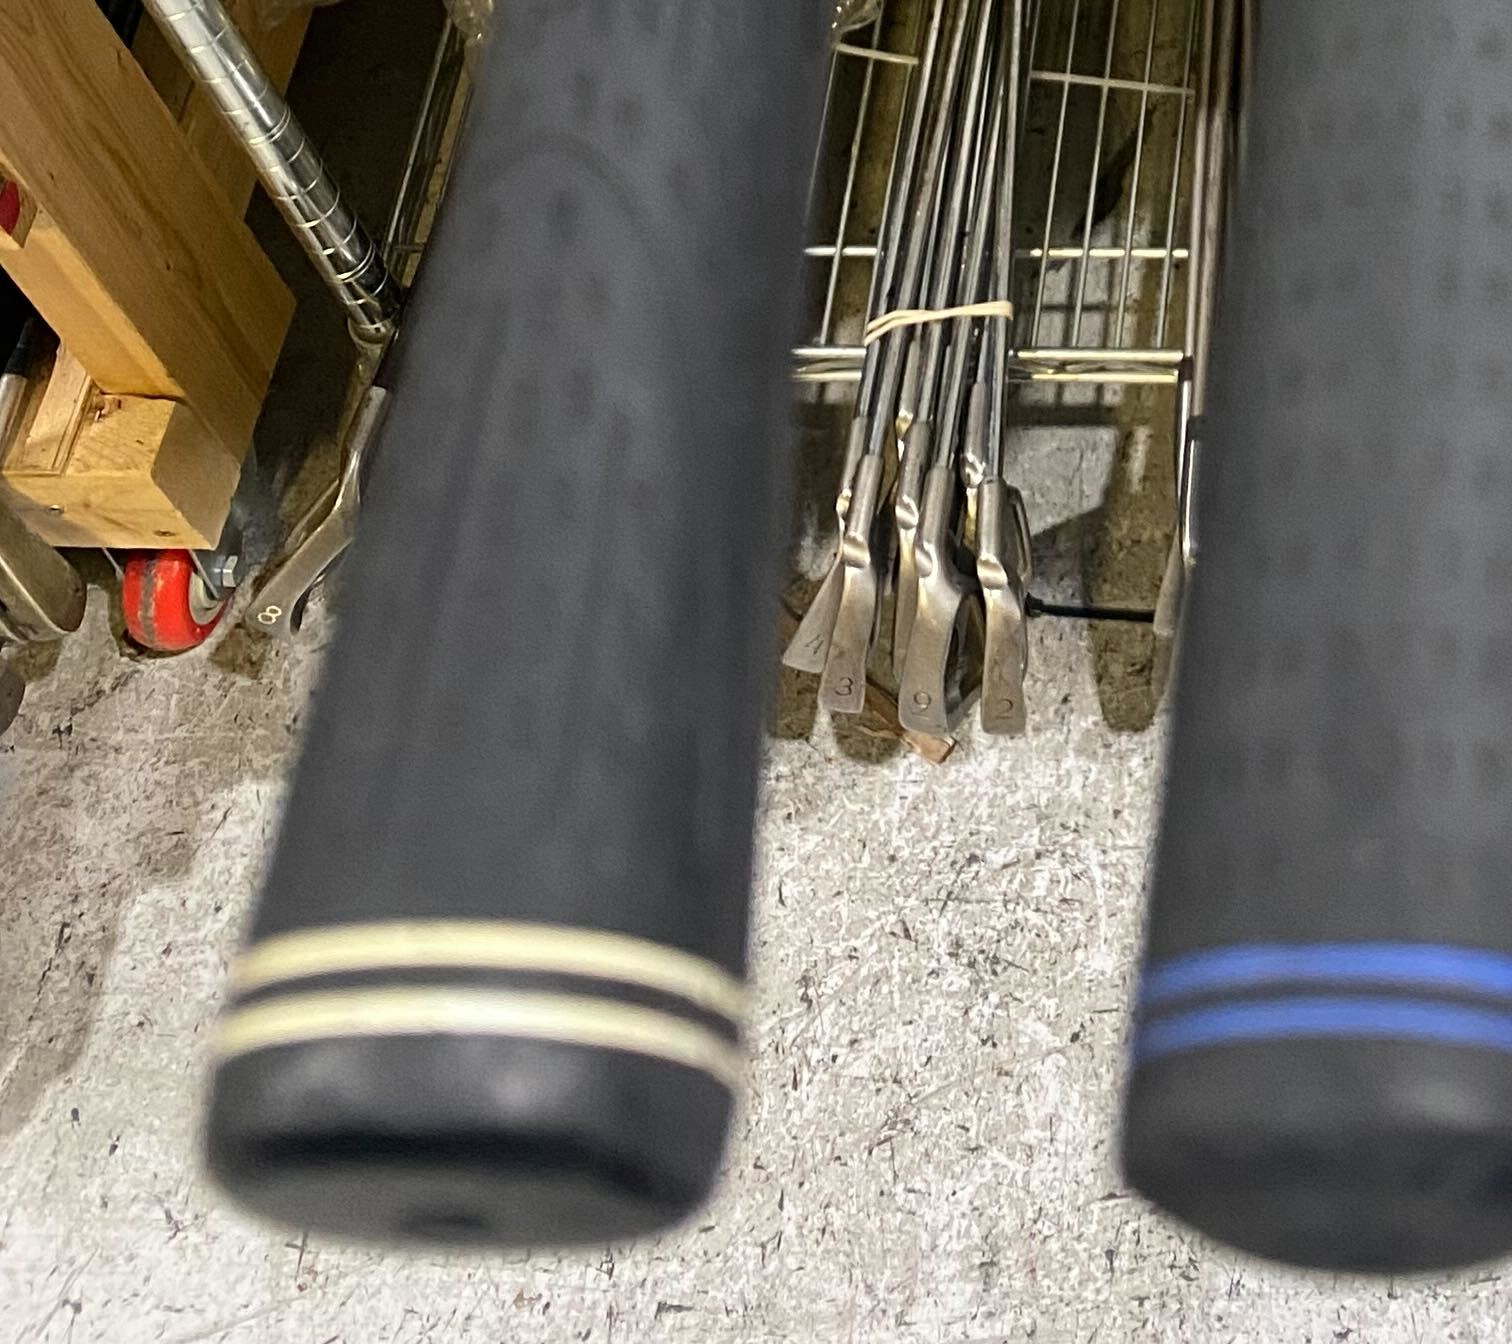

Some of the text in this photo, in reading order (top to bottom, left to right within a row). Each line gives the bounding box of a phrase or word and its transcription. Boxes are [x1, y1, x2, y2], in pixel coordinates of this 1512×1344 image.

[256, 604, 283, 625] 8
[833, 676, 855, 697] 3
[994, 697, 1015, 720] 2
